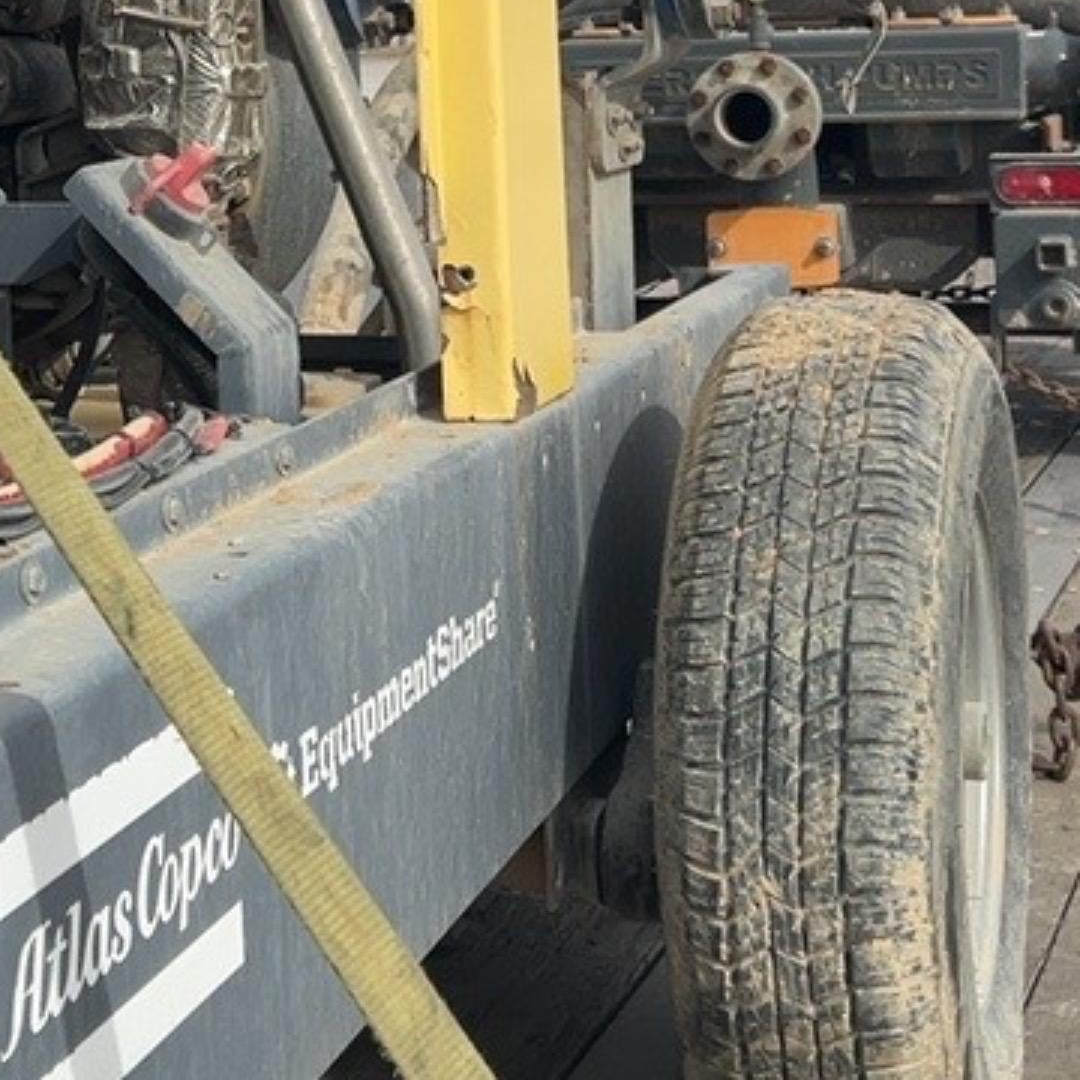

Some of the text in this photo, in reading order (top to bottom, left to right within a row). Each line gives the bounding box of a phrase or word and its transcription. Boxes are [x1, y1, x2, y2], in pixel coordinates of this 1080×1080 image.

[299, 599, 498, 798] EquipmentShare
[0, 812, 241, 1062] Atlas Copco
